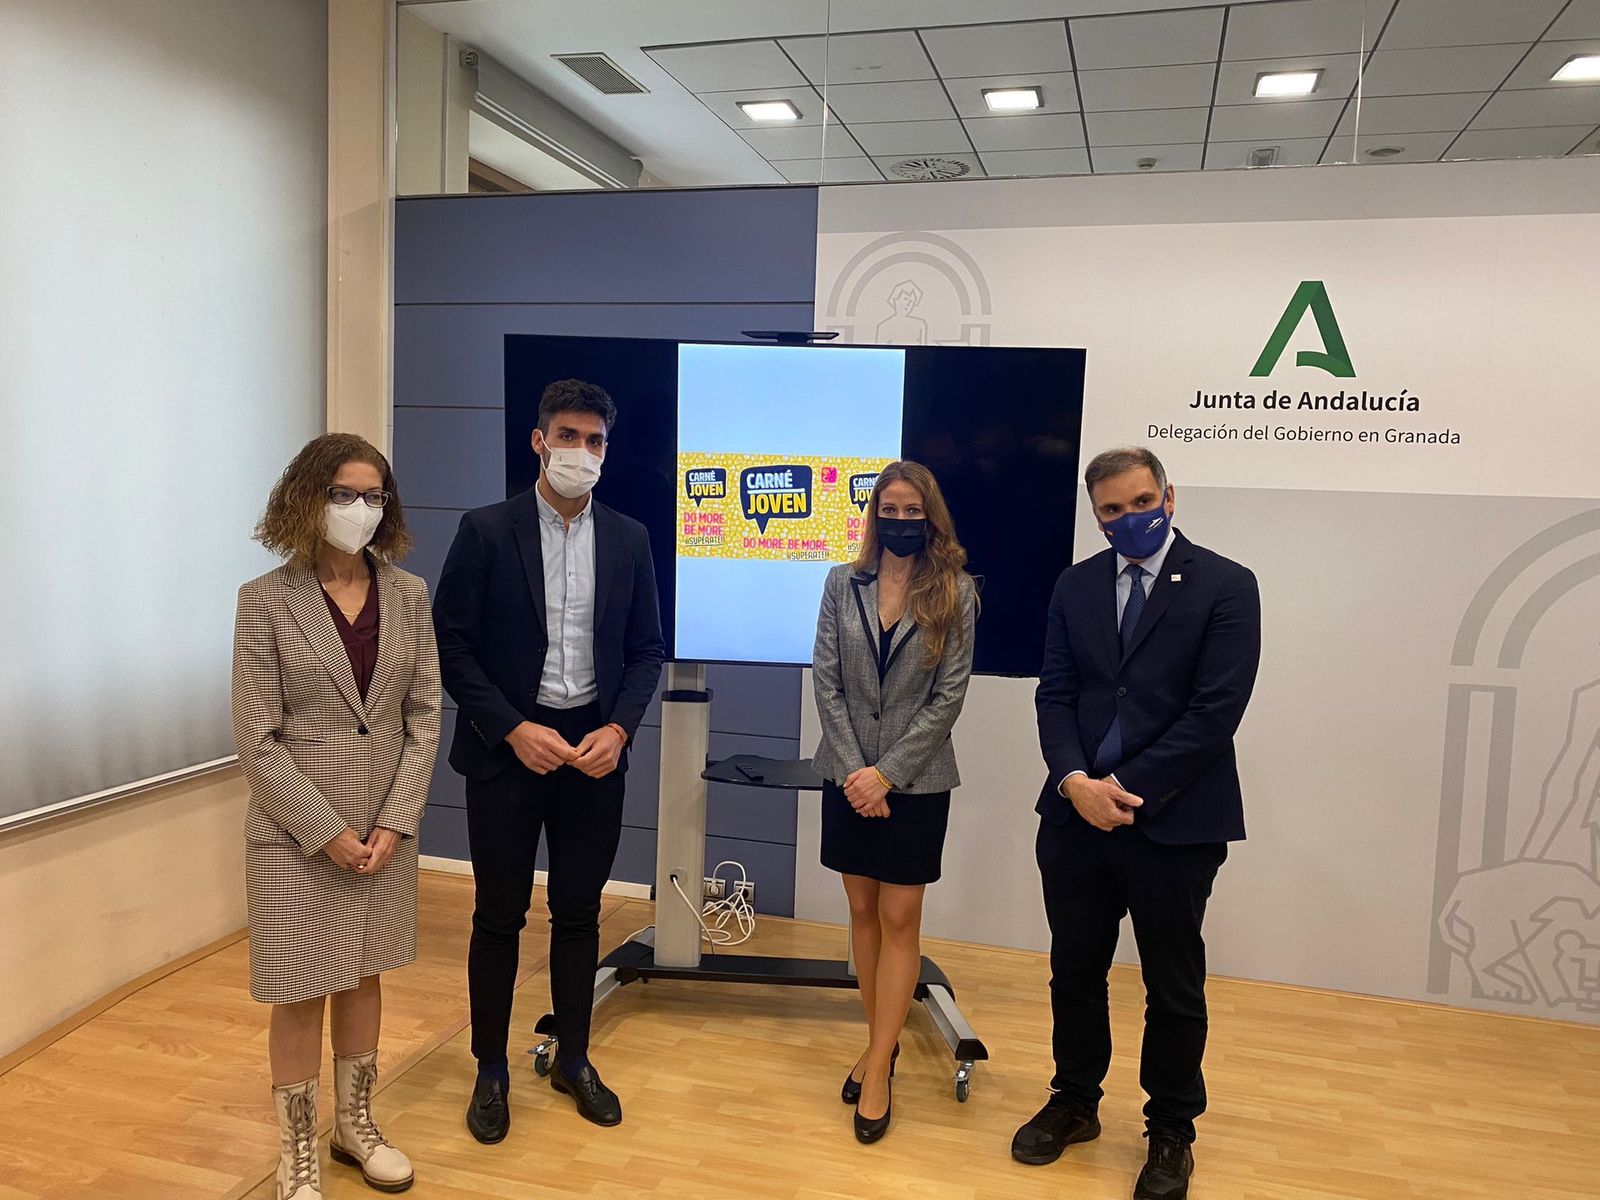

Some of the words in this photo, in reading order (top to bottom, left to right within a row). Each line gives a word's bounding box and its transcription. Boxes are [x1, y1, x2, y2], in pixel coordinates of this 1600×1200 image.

[1189, 390, 1256, 410] Junta
[1263, 390, 1292, 410] de
[1297, 389, 1420, 412] Andalucía
[1147, 423, 1239, 443] Delegación
[1242, 425, 1269, 441] del
[1274, 426, 1353, 442] Gobierno
[1358, 431, 1379, 442] en
[1384, 428, 1461, 445] Granada
[689, 470, 716, 482] CARNÉ
[746, 469, 793, 489] CARNÉ
[689, 484, 724, 497] JOVEN
[853, 489, 873, 502] JOV
[747, 492, 807, 514] JOVEN
[684, 512, 697, 523] DO
[847, 517, 860, 529] DO
[684, 524, 697, 535] BE
[847, 530, 859, 541] BE
[743, 537, 756, 549] DO
[787, 538, 800, 550] BE
